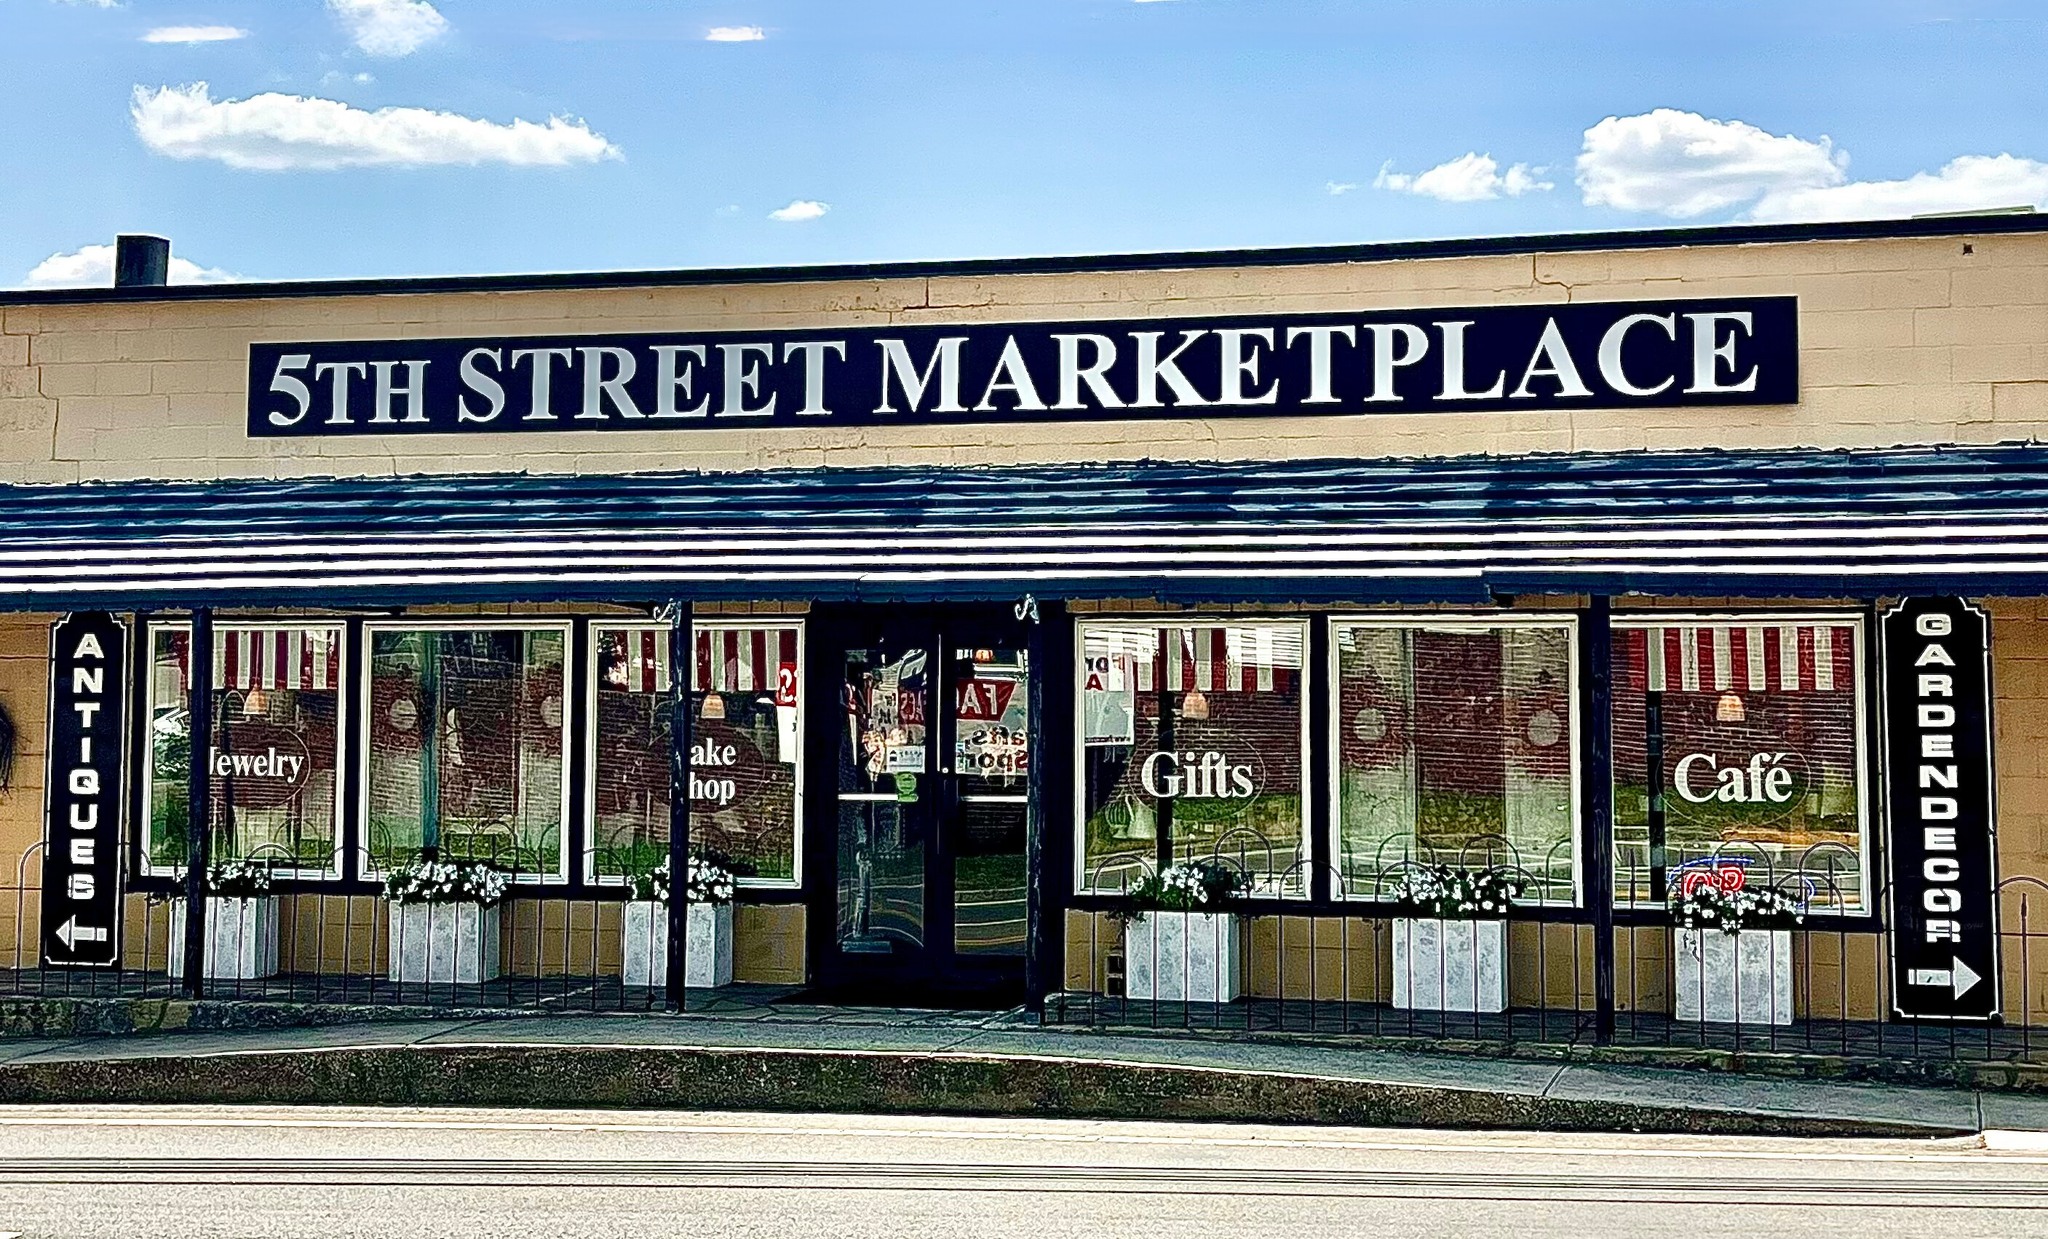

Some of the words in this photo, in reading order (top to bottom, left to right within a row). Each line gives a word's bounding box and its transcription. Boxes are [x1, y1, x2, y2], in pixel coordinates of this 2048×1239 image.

[267, 354, 431, 426] 5TH
[457, 339, 846, 422] STREET
[873, 310, 1760, 415] MARKETPLACE
[68, 633, 105, 900] ANTIQUES
[690, 737, 736, 766] ake
[1141, 751, 1254, 798] Gifts
[689, 771, 736, 806] hop
[1674, 752, 1793, 803] Café
